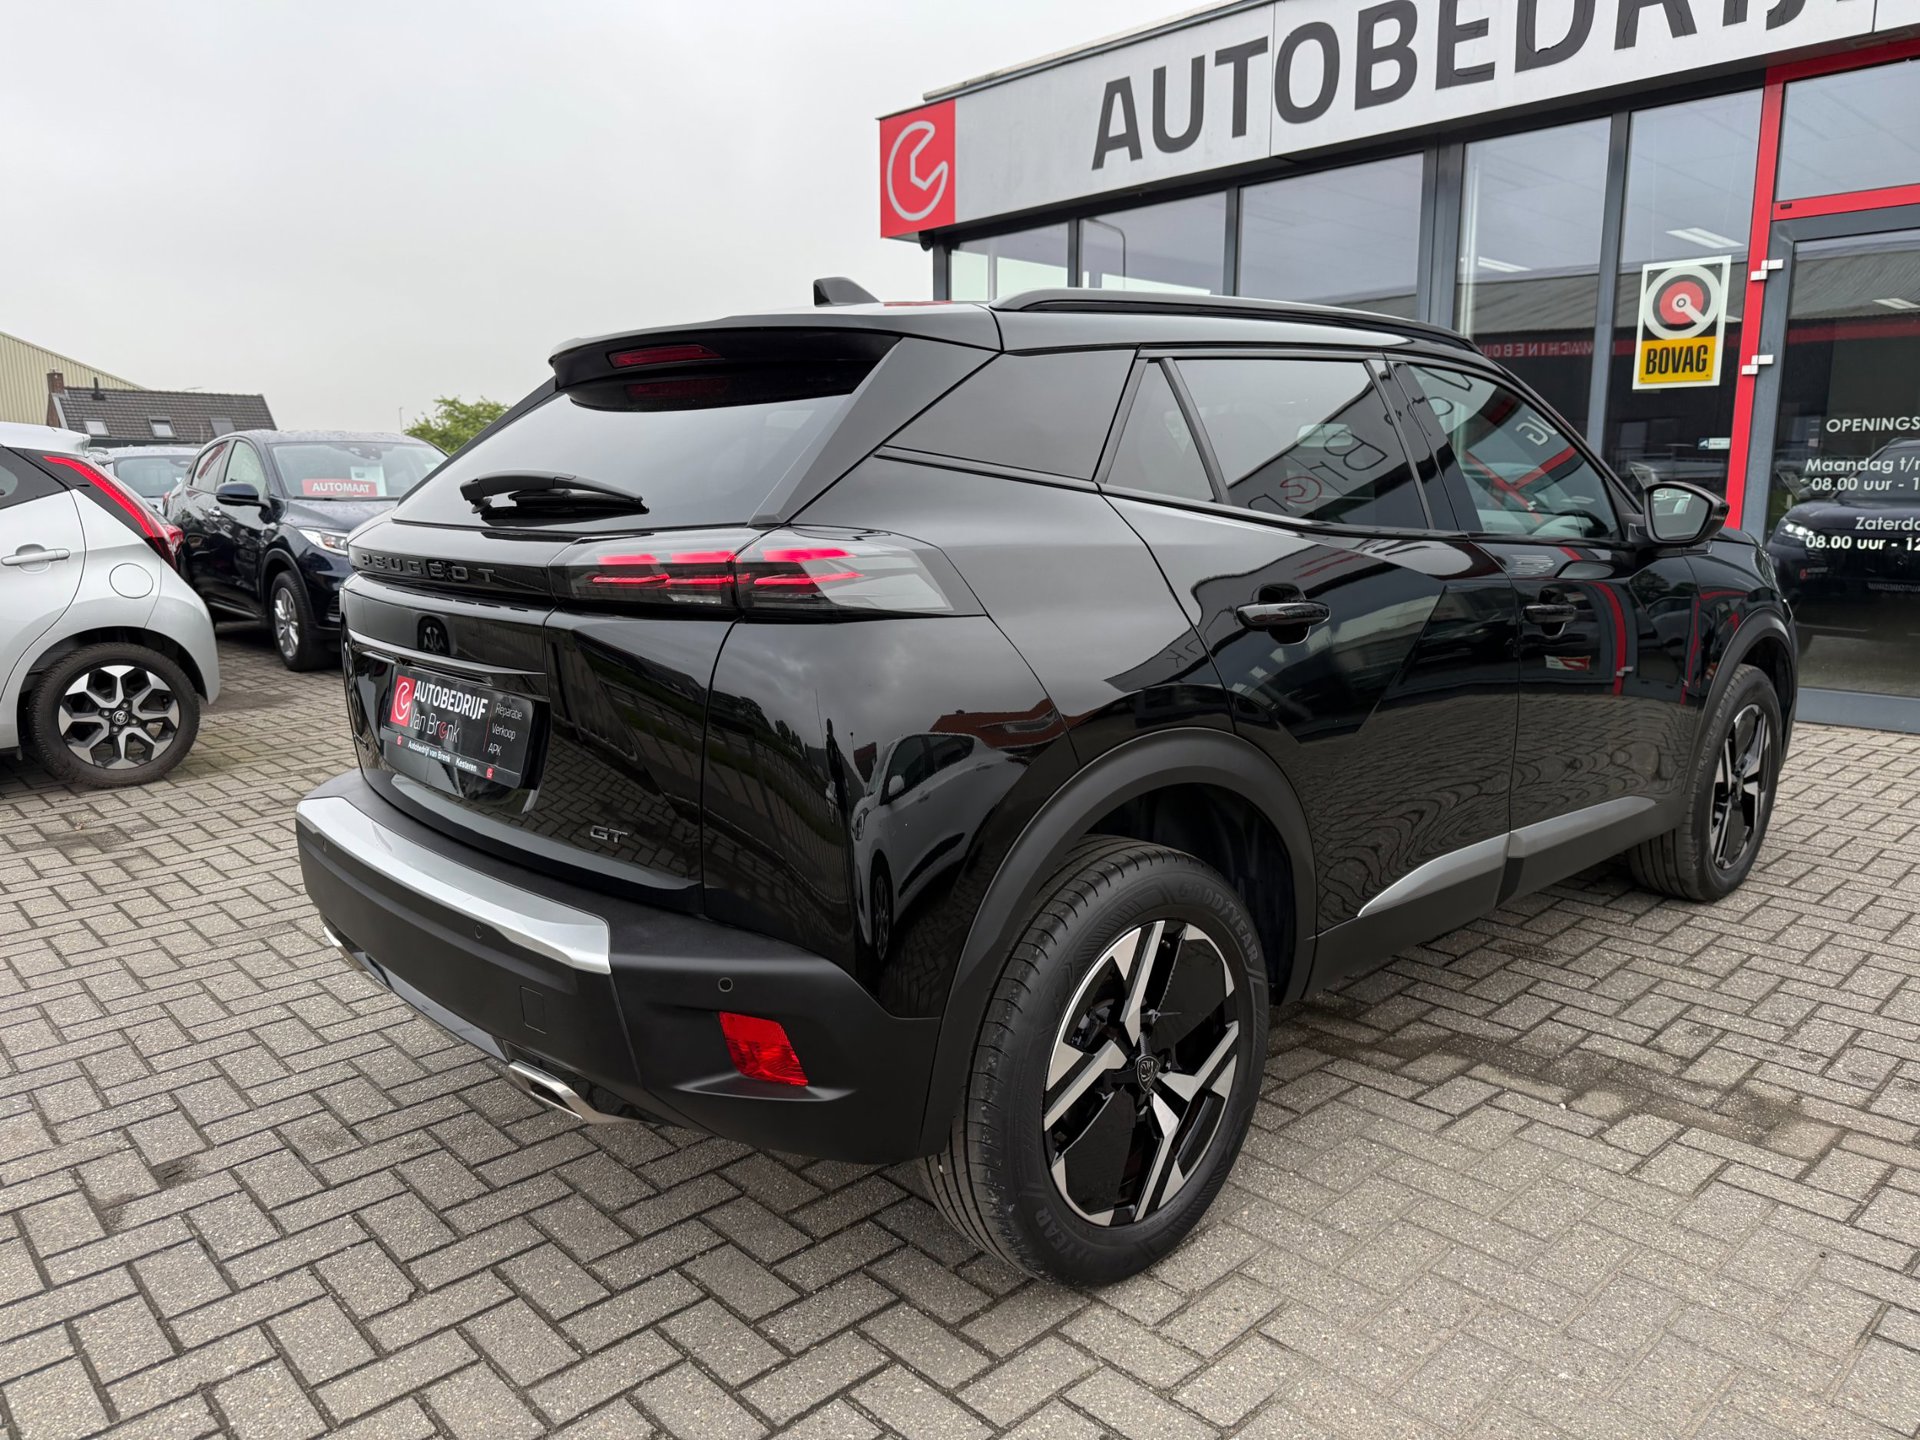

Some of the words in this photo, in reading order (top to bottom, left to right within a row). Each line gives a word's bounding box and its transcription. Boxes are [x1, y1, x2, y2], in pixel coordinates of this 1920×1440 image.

[1092, 0, 1848, 170] AUTOBED
[1645, 344, 1709, 375] BOVAG
[1826, 416, 1920, 432] OPENINGS
[1805, 457, 1894, 474] Maandag
[312, 482, 369, 493] AUTOMAAT
[1811, 477, 1858, 491] 08.00
[1863, 480, 1892, 491] uur
[1805, 535, 1852, 549] 08.00
[1856, 539, 1886, 550] uur
[361, 553, 494, 582] PEUGEOT
[413, 680, 489, 720] AUTOBEDRIJF
[410, 707, 426, 731] Van
[495, 702, 523, 721] Reparatie
[492, 723, 516, 742] Verkoop
[488, 742, 502, 756] APK
[429, 749, 438, 758] van
[438, 750, 451, 763] Brenk
[455, 757, 477, 772] Kesteren
[590, 825, 628, 844] GT
